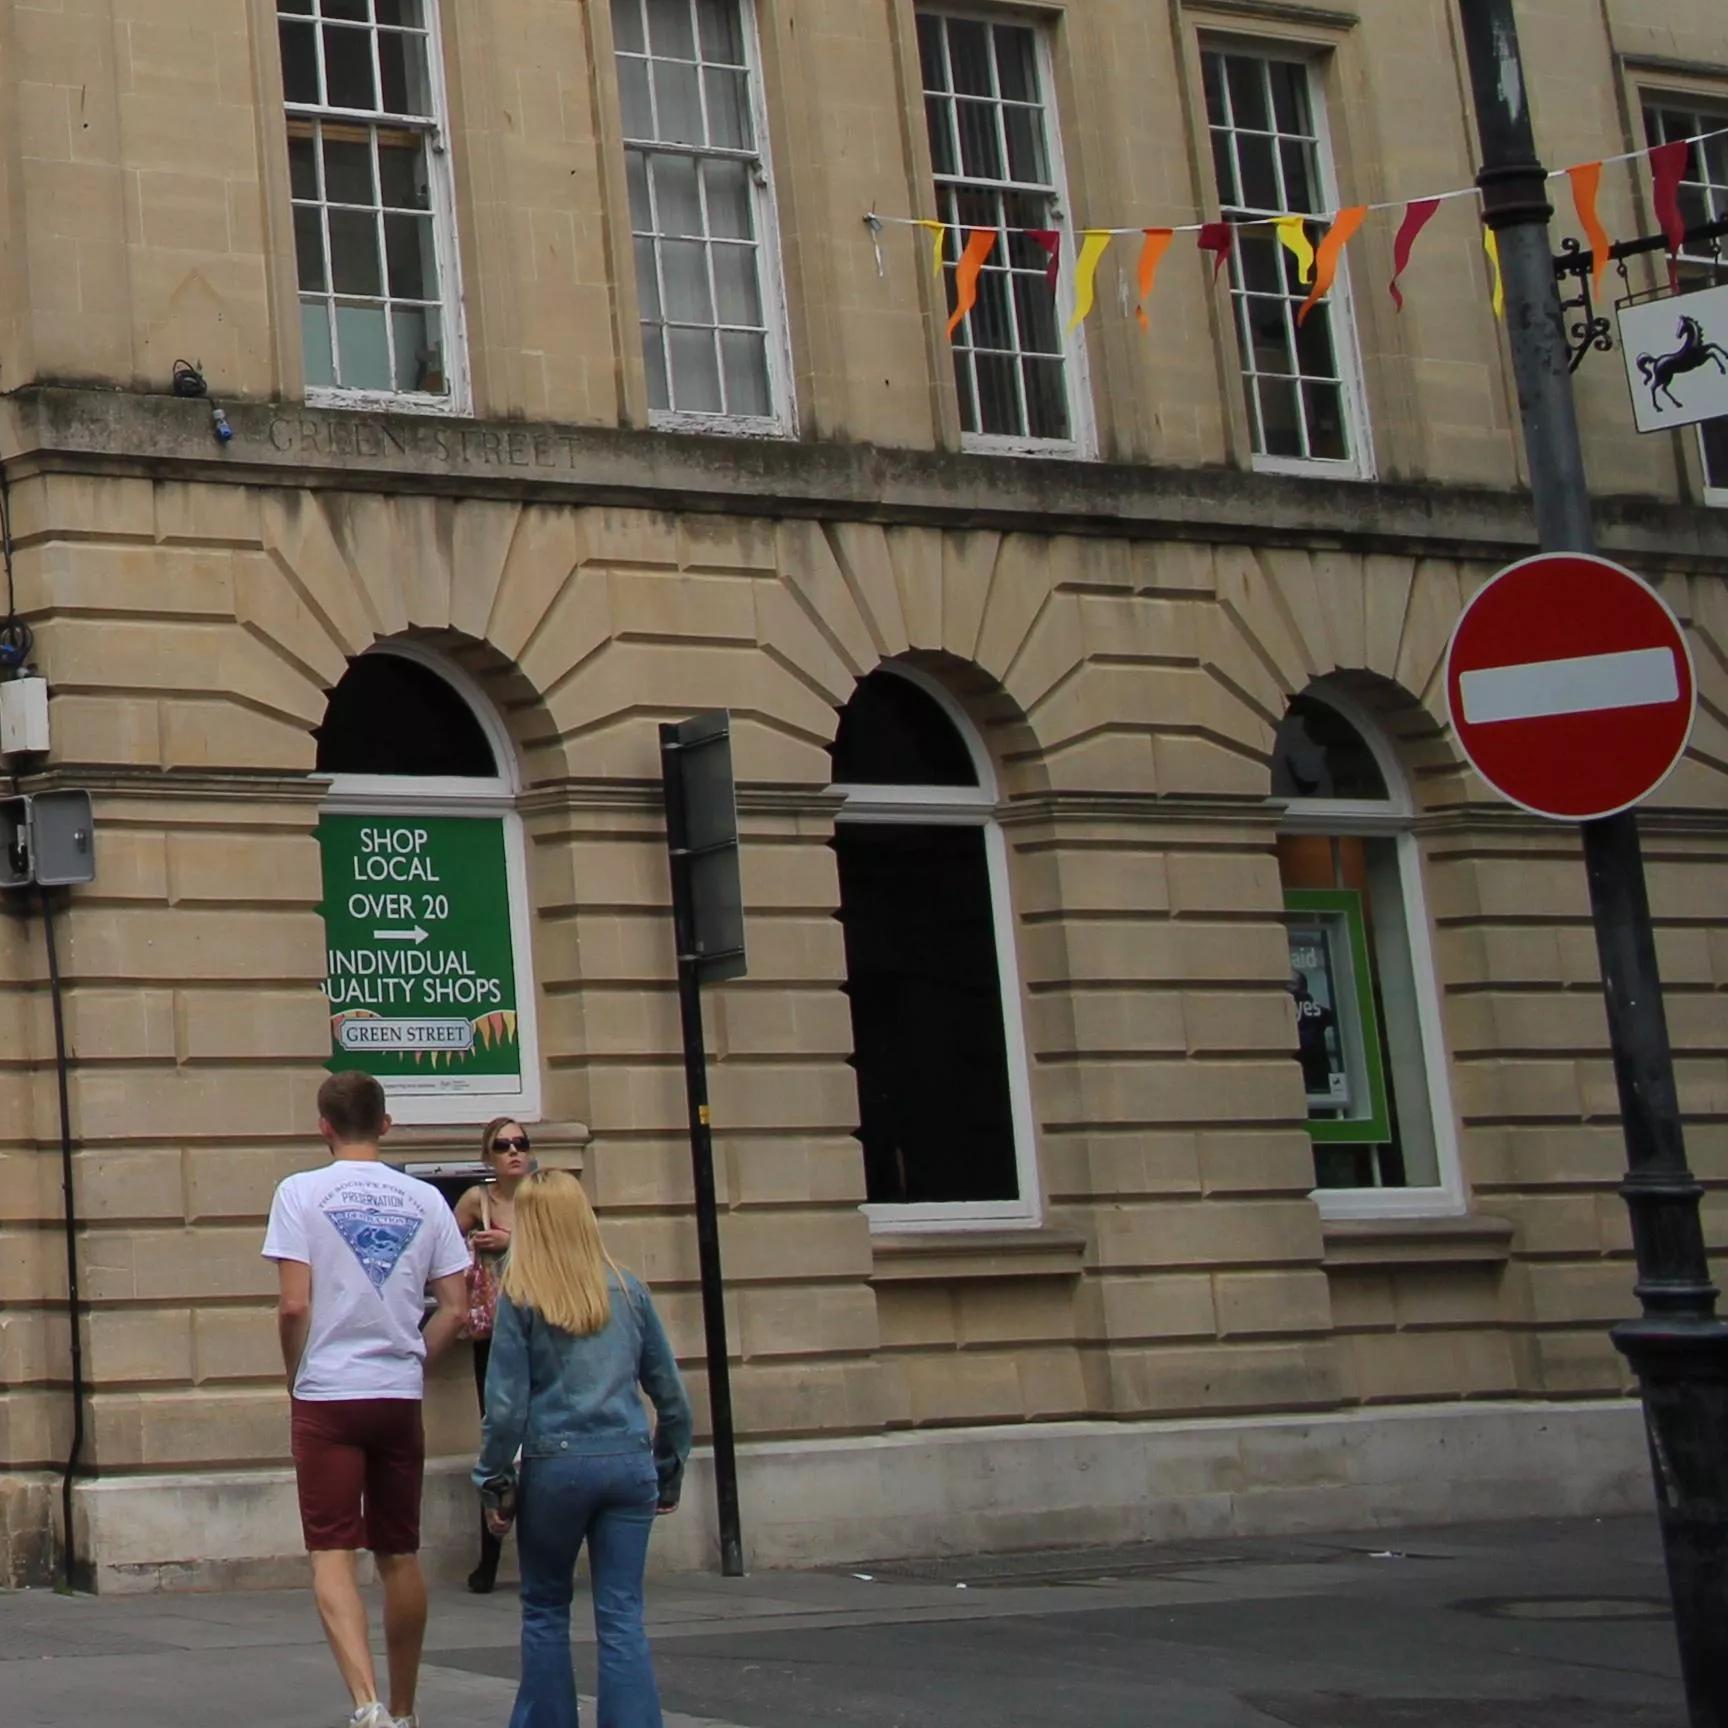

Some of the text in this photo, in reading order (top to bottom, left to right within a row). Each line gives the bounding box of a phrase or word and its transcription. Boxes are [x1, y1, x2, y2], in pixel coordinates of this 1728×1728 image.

[360, 828, 428, 854] SHOP
[353, 855, 440, 881] LOCAL
[348, 893, 449, 919] OVER 20
[328, 949, 476, 975] INDIVIDUAL
[321, 977, 502, 1003] UALITY SHOPS
[346, 1026, 465, 1042] GREEN STREET
[341, 1191, 404, 1208] PRESERVATION
